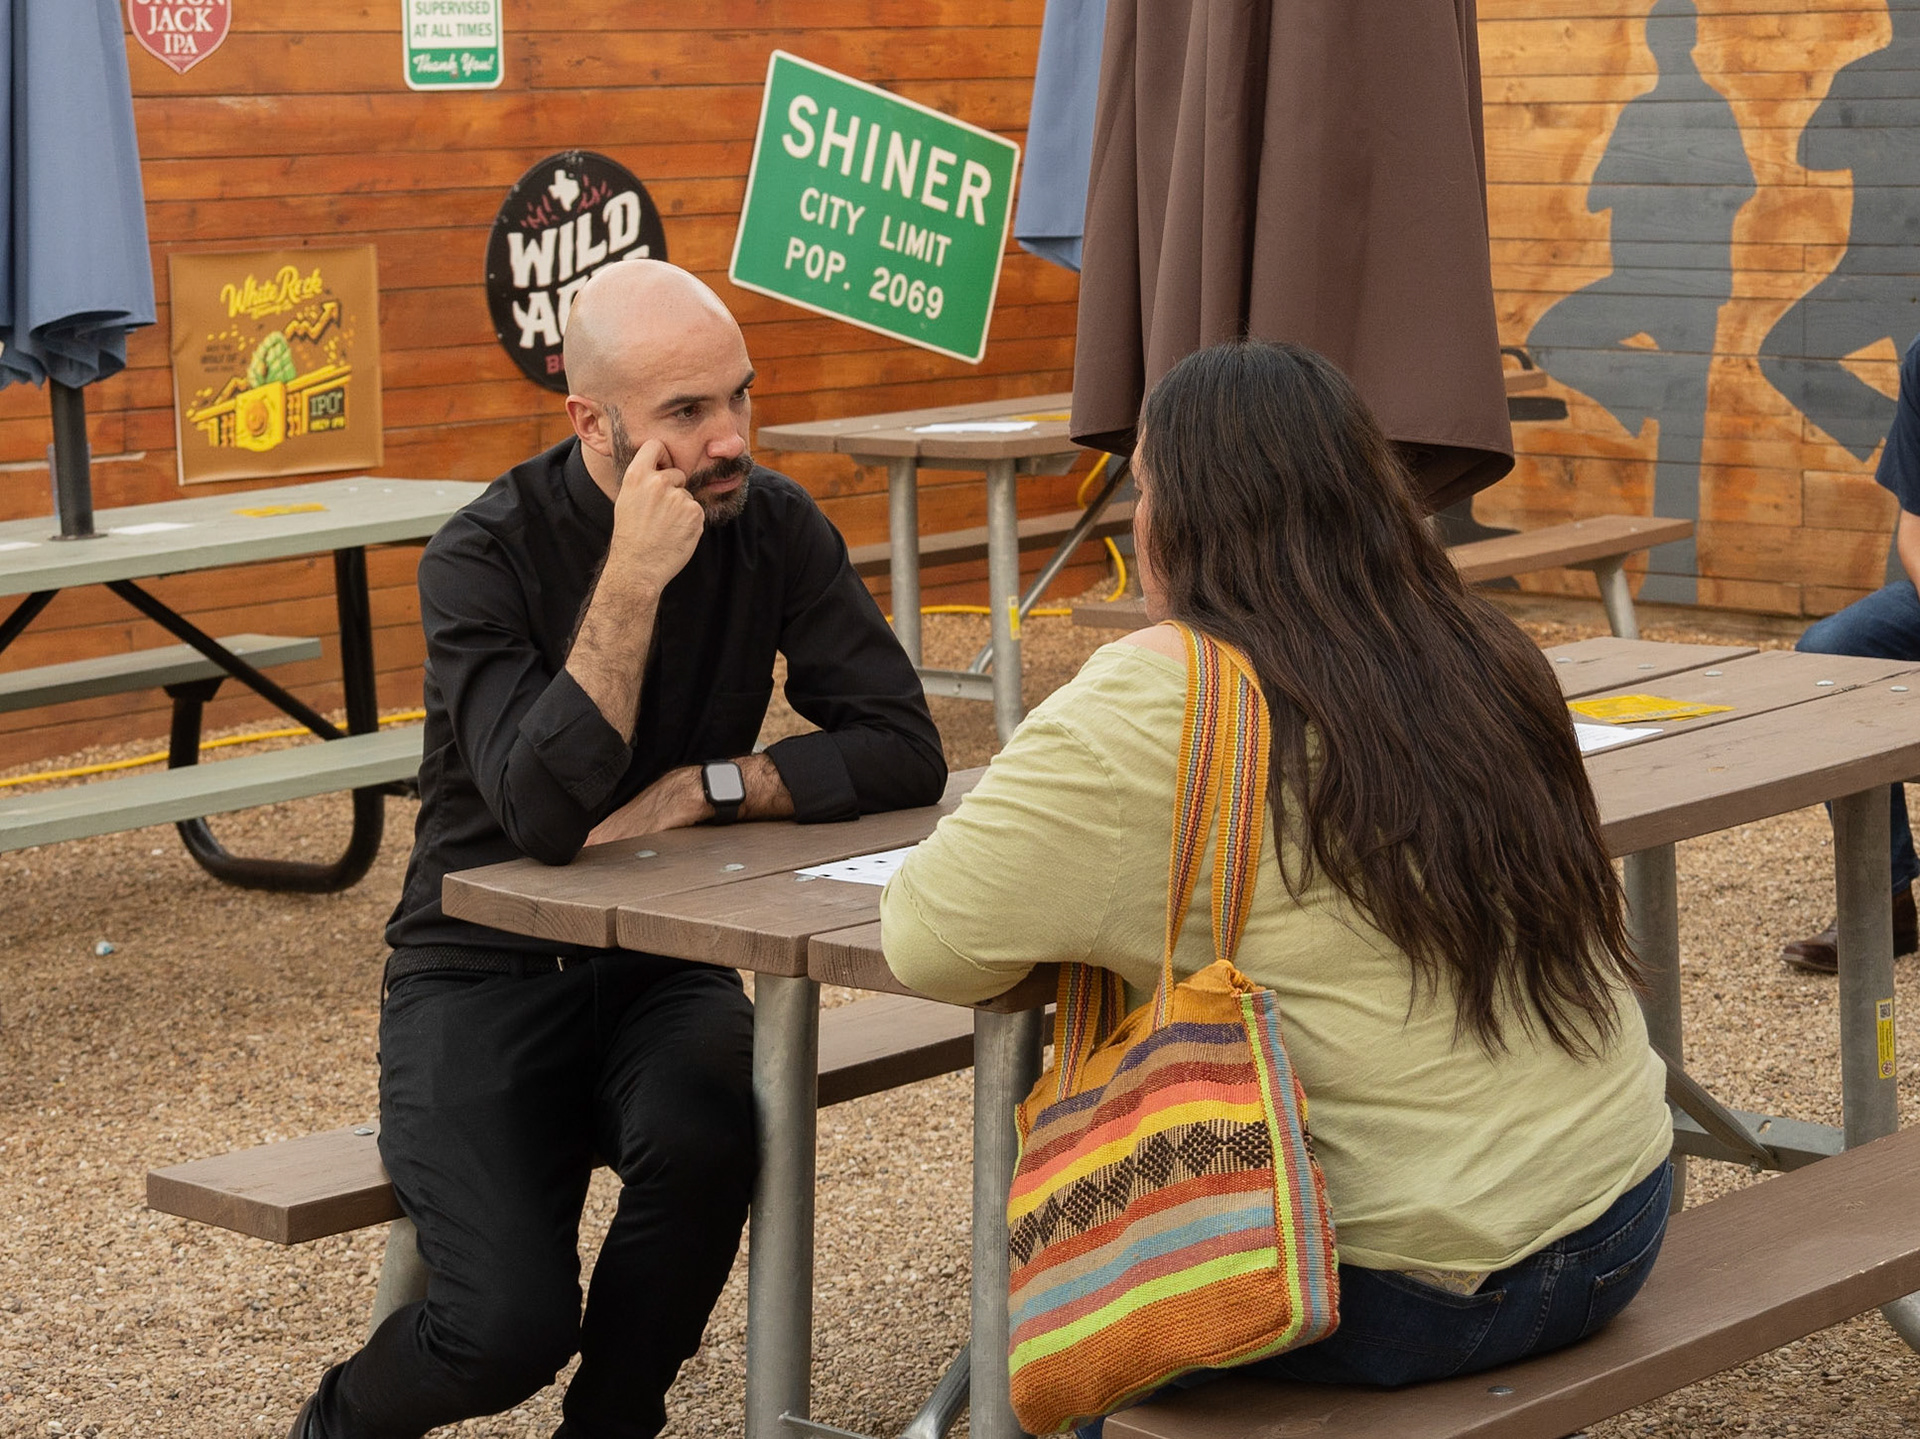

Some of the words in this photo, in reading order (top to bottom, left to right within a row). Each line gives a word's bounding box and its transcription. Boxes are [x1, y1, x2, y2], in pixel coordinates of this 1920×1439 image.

[147, 6, 214, 35] JACK
[415, 1, 491, 15] SUPERVISED
[164, 33, 198, 54] IPA
[414, 24, 428, 37] AT
[431, 24, 452, 37] ALL
[456, 23, 492, 37] TIMES
[413, 53, 458, 74] Thank
[782, 95, 992, 226] SHINER
[507, 190, 641, 288] WILD
[799, 187, 866, 236] CITY
[880, 215, 952, 267] LIMIT
[220, 274, 278, 318] White
[276, 265, 323, 304] Rock
[784, 236, 851, 290] POP.
[869, 267, 944, 320] 2069
